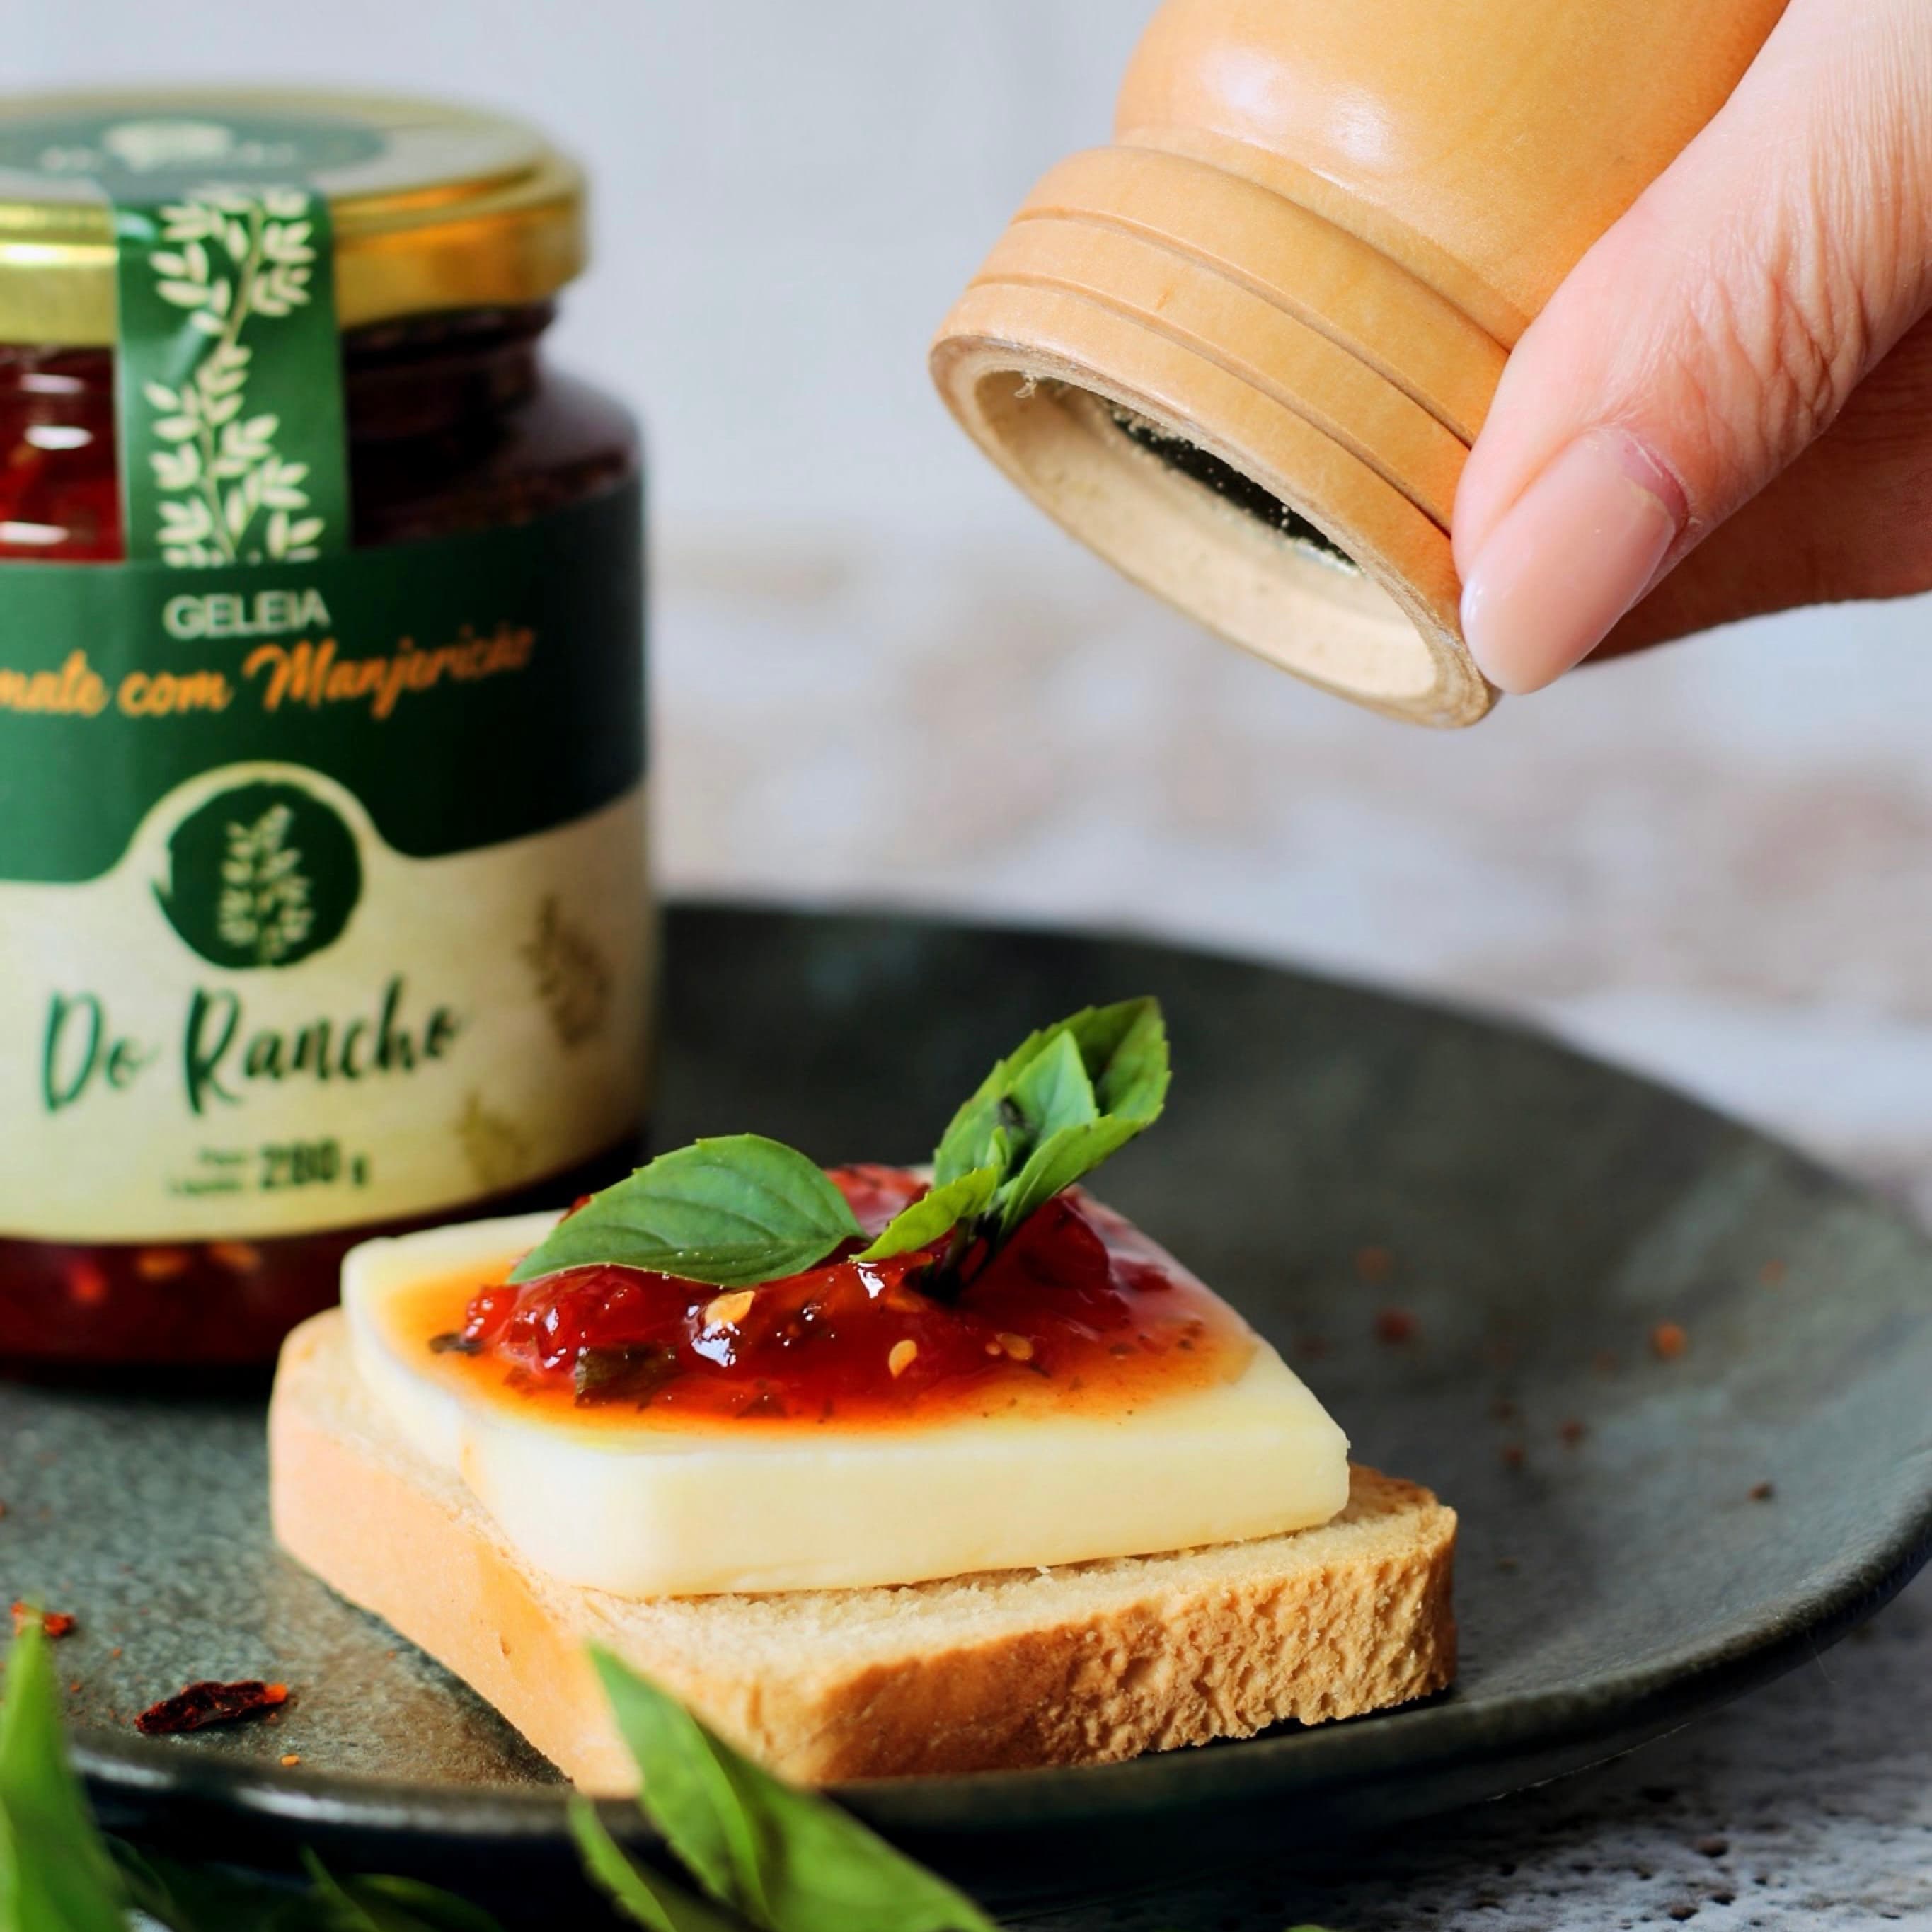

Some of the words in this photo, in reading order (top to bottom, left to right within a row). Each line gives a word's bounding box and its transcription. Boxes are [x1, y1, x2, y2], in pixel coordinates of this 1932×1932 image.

[163, 588, 331, 640] GELEIA
[117, 669, 234, 718] com
[41, 989, 156, 1115] Do
[184, 974, 464, 1117] Rancho
